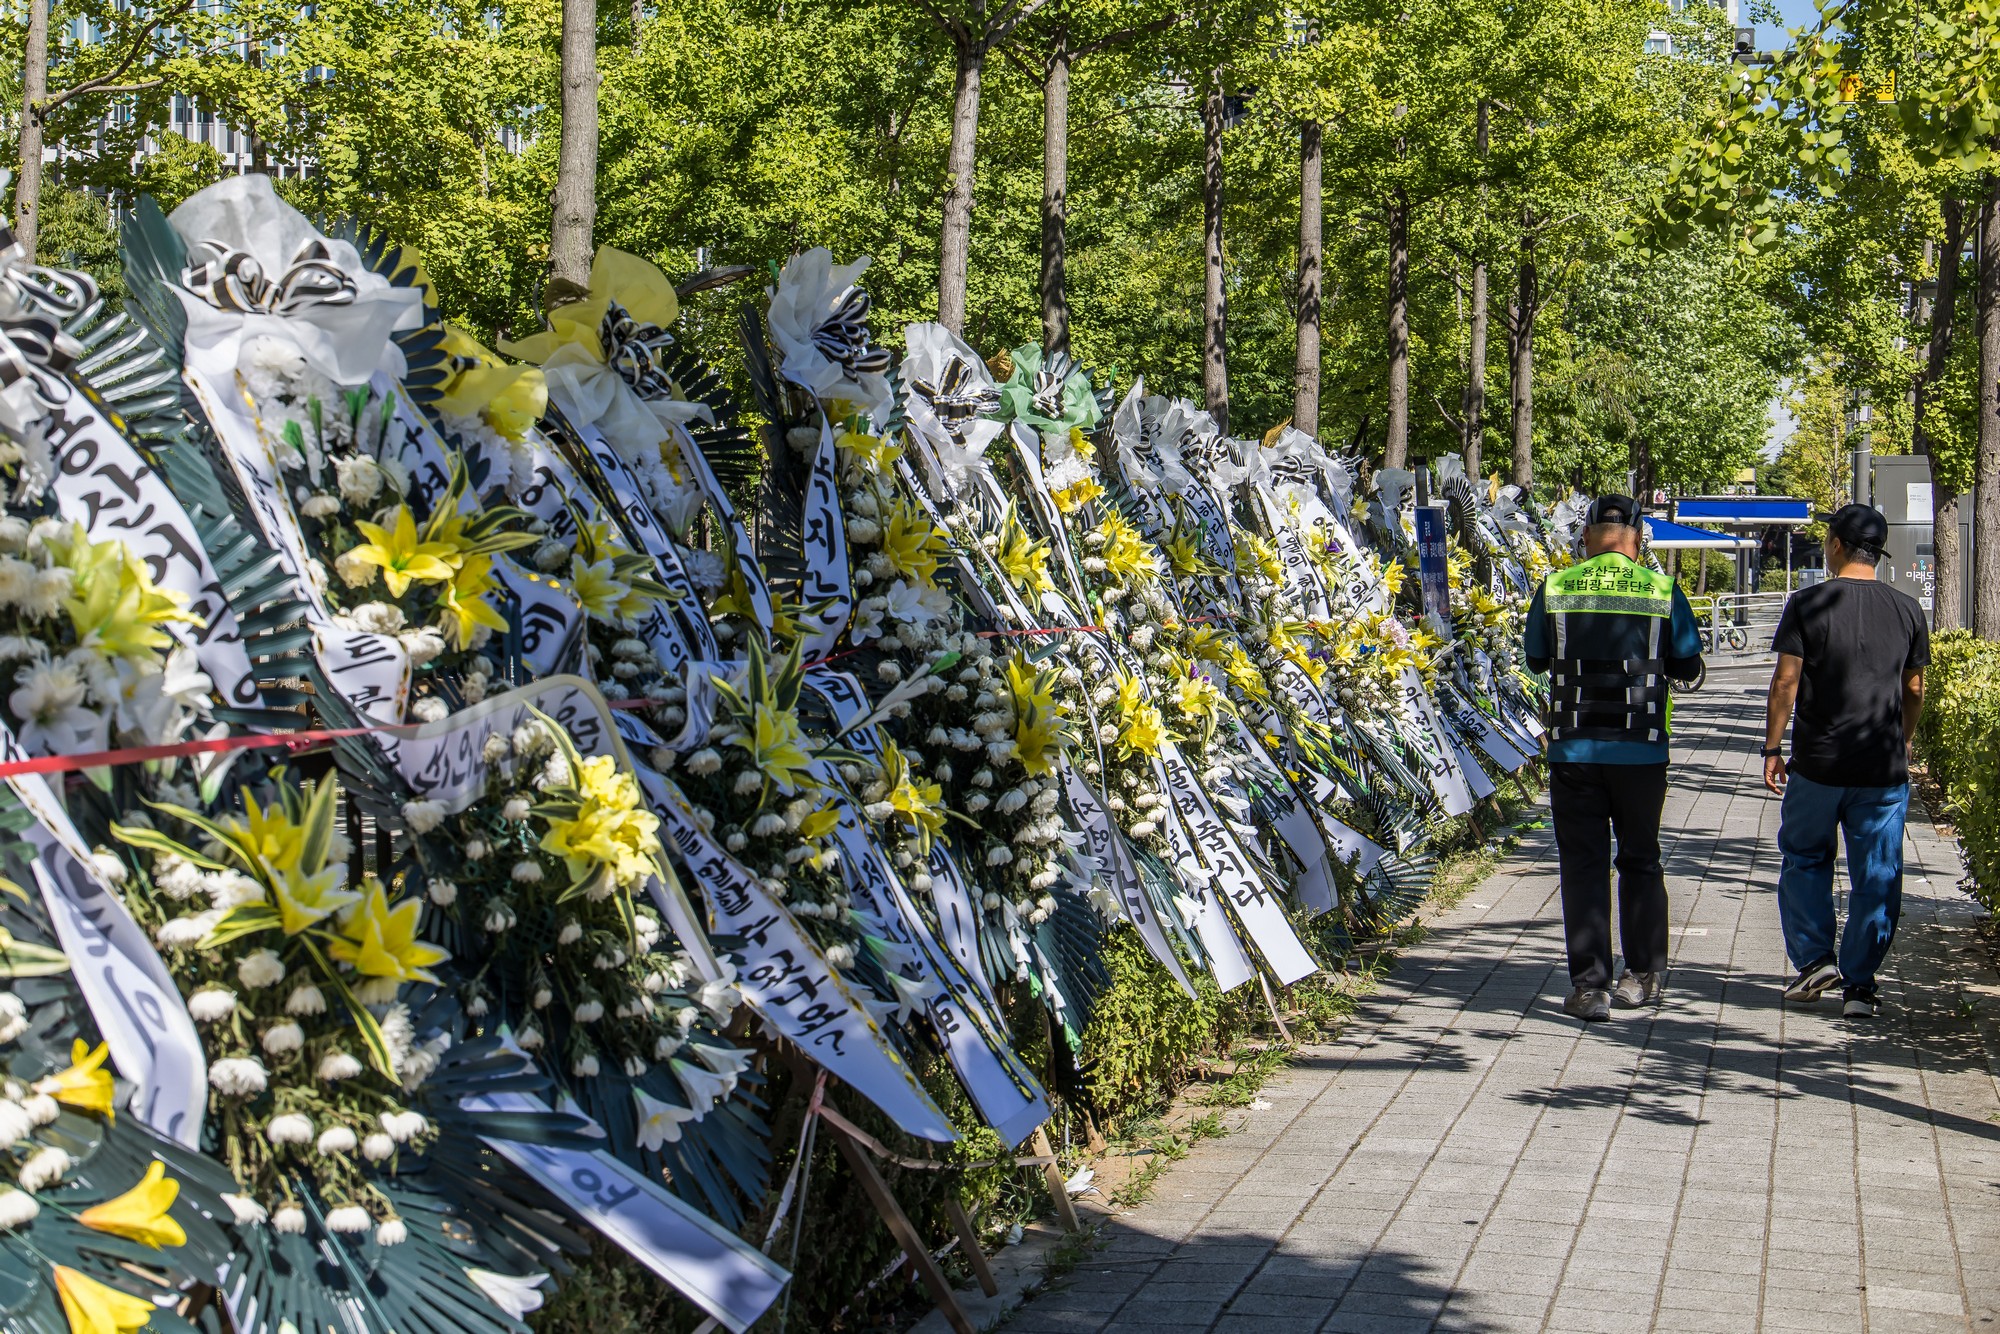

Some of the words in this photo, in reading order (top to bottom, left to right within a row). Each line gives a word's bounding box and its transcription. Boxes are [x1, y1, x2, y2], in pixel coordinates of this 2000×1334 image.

[1563, 579, 1656, 595] 불법광고물단속
[1581, 566, 1634, 579] 용산구청
[1165, 758, 1269, 909] 물려줍시다
[735, 914, 780, 949] 수
[747, 948, 849, 1057] 있나요?
